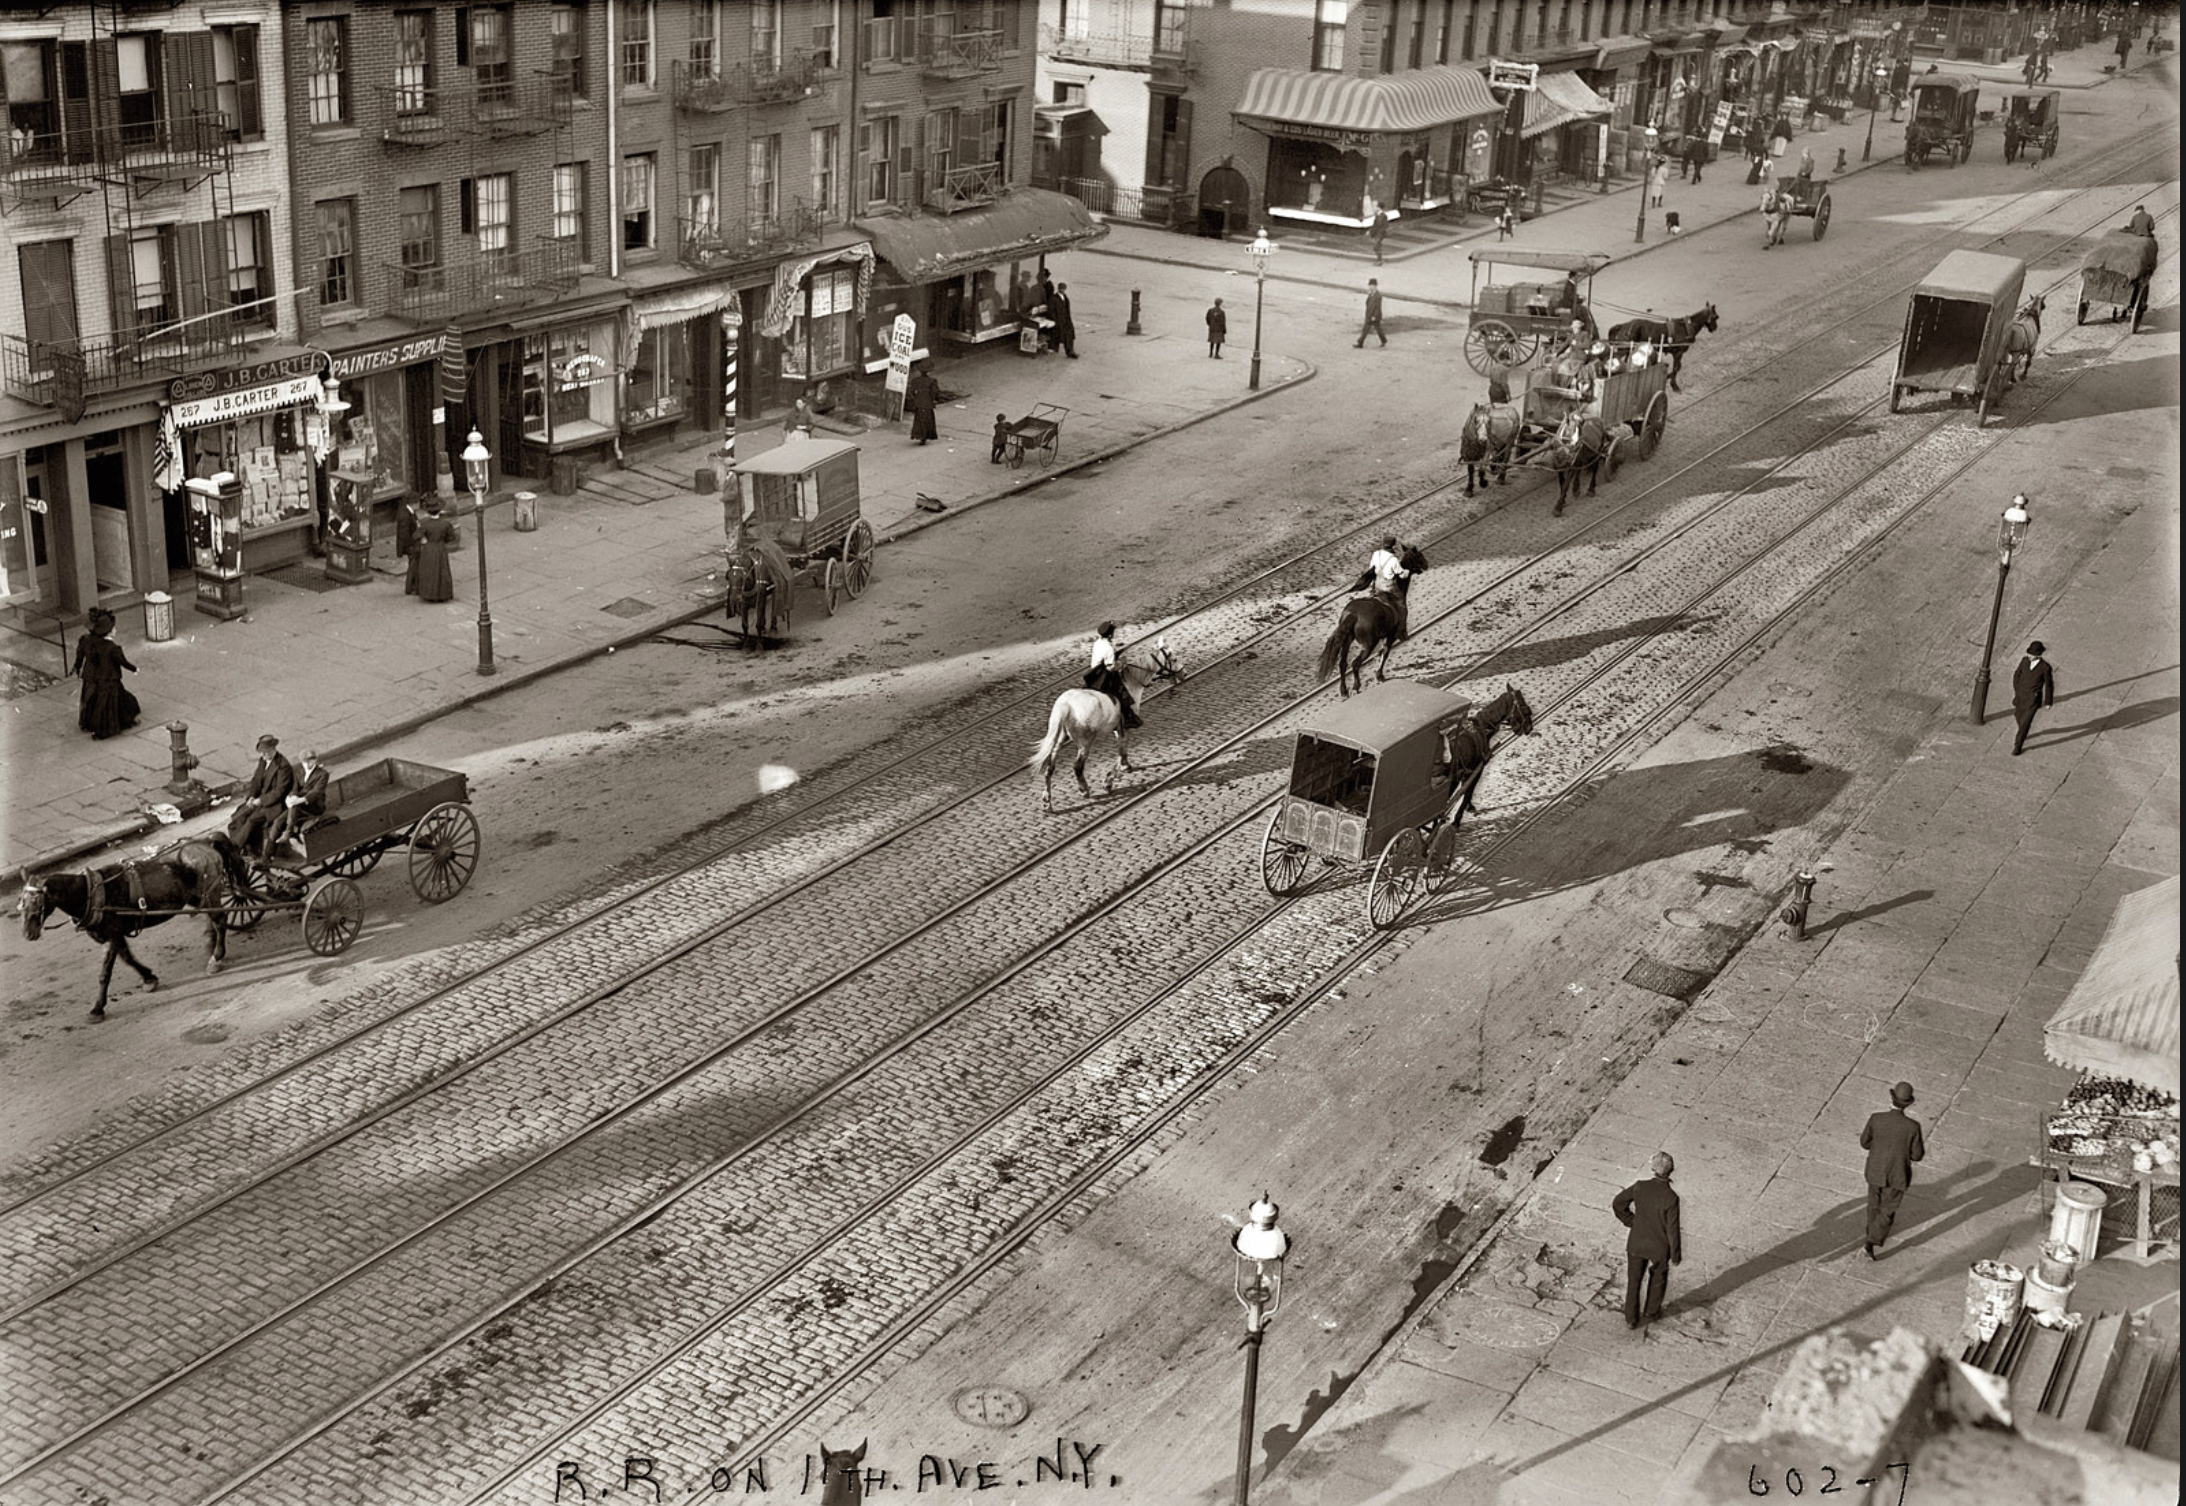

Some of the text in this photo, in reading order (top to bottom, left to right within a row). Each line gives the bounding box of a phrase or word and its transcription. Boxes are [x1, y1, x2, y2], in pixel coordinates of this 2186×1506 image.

[895, 331, 912, 346] ICE
[892, 342, 910, 357] COAL
[332, 347, 399, 376] PAINTERS
[889, 361, 908, 375] WOOD
[180, 404, 200, 418] 267
[290, 381, 307, 394] 267
